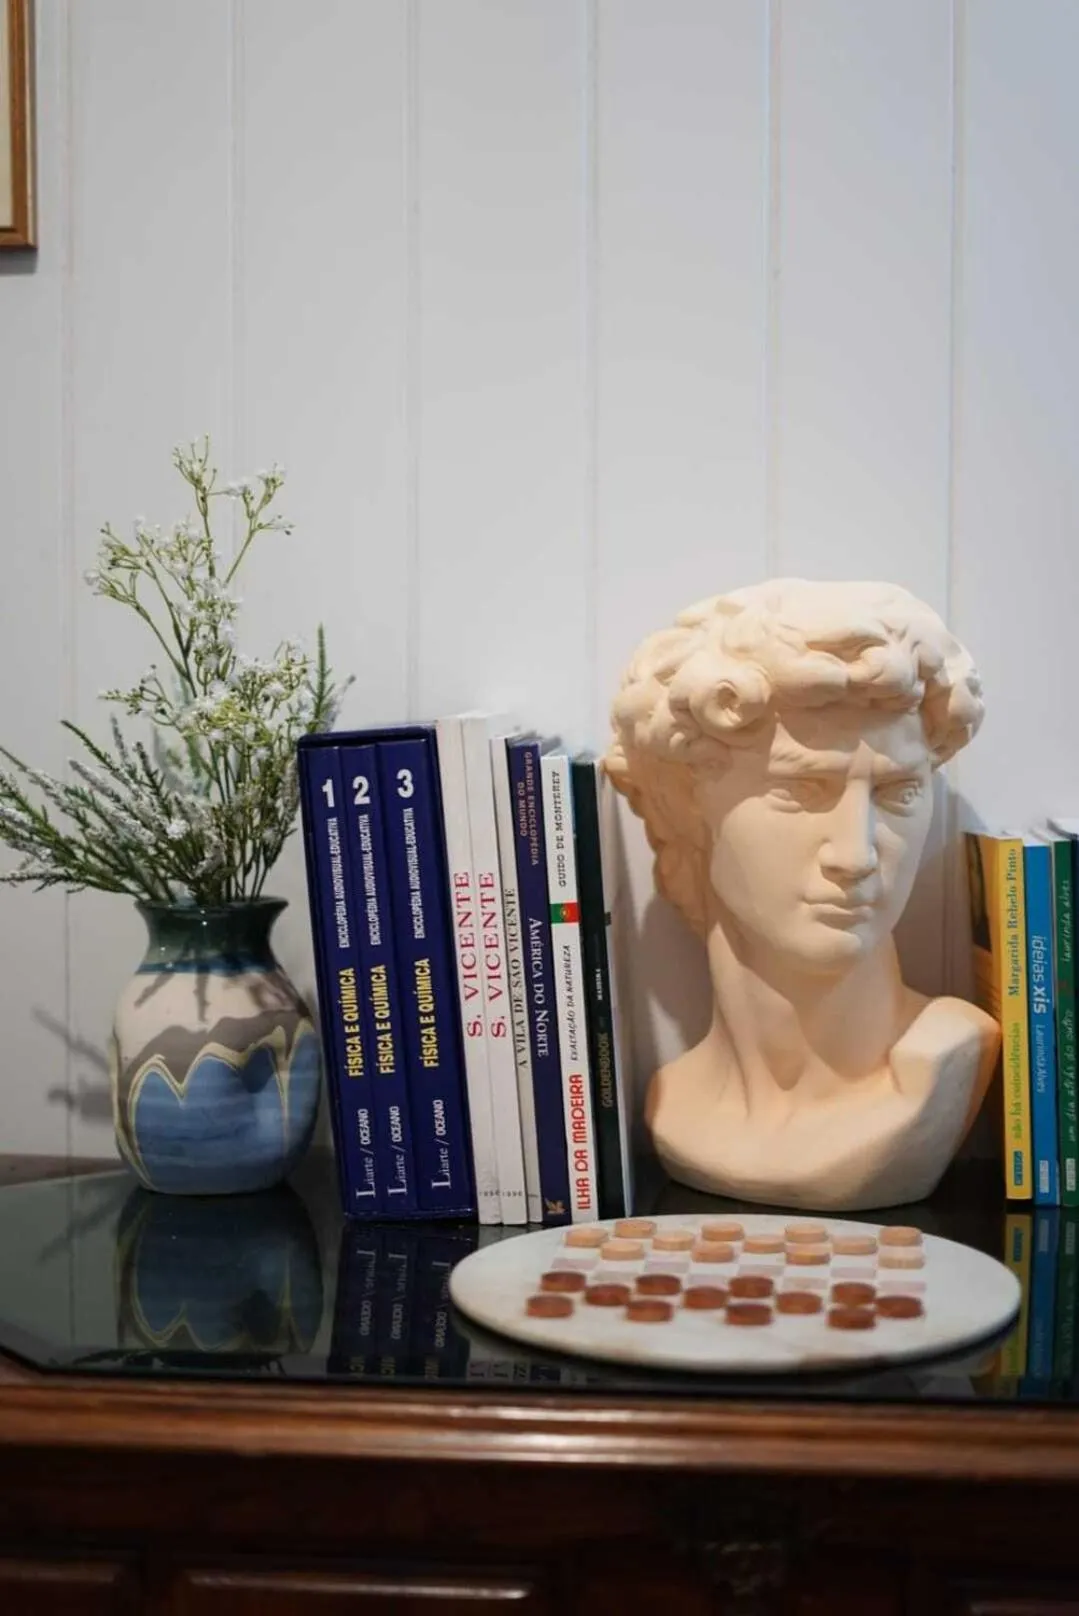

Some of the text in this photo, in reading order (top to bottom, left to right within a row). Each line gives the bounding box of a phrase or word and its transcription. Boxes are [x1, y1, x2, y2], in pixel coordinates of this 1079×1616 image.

[322, 778, 335, 808] 1
[353, 776, 371, 805] 2
[397, 769, 414, 798] 3
[518, 799, 528, 837] MUNDO
[553, 771, 567, 888] GUIDO DE MONTEREY
[504, 888, 519, 954] VICENTE
[1006, 848, 1021, 996] Margarida Rebelo Pinto
[454, 872, 483, 1038] S. VICENTE
[479, 872, 507, 1038] S. VICENTE
[1032, 935, 1050, 1014] ideias xis
[413, 958, 439, 1068] FÍSICA E QUÍMICA
[511, 994, 523, 1013] DE
[534, 988, 546, 1005] DO
[338, 967, 364, 1077] FÍSICA E QUÍMICA
[369, 964, 396, 1074] FÍSICA E QUÍMICA
[514, 1020, 527, 1054] VILA
[517, 1060, 528, 1068] A
[357, 1109, 371, 1145] OCEANO
[389, 1106, 403, 1142] OCEANO
[433, 1099, 447, 1136] OCEANO
[569, 1074, 591, 1211] ILHA DA MADEIRA
